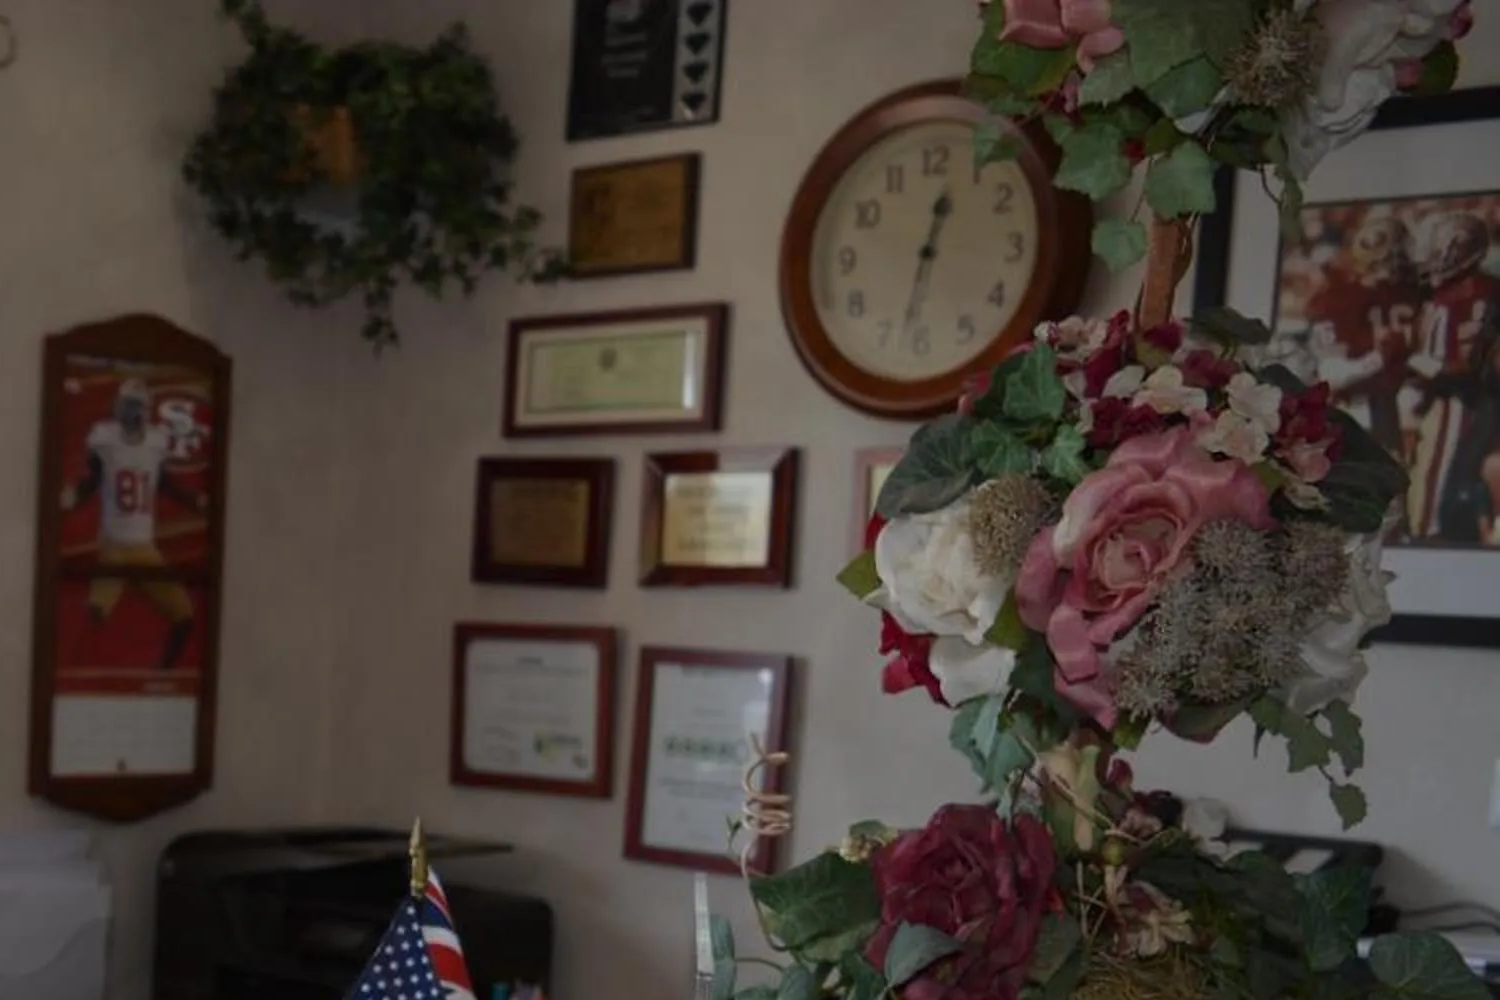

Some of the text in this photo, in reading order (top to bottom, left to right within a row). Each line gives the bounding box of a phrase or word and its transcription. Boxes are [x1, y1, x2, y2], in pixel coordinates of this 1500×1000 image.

[920, 146, 950, 177] 12
[885, 165, 904, 194] 11
[854, 198, 882, 230] 10
[992, 183, 1014, 215] 2
[839, 247, 857, 276] 9
[1004, 231, 1025, 263] 3
[848, 290, 866, 318] 8
[987, 280, 1006, 309] 4
[876, 319, 893, 347] 7
[911, 325, 931, 356] 6
[956, 313, 976, 345] 5
[115, 467, 151, 513] 81
